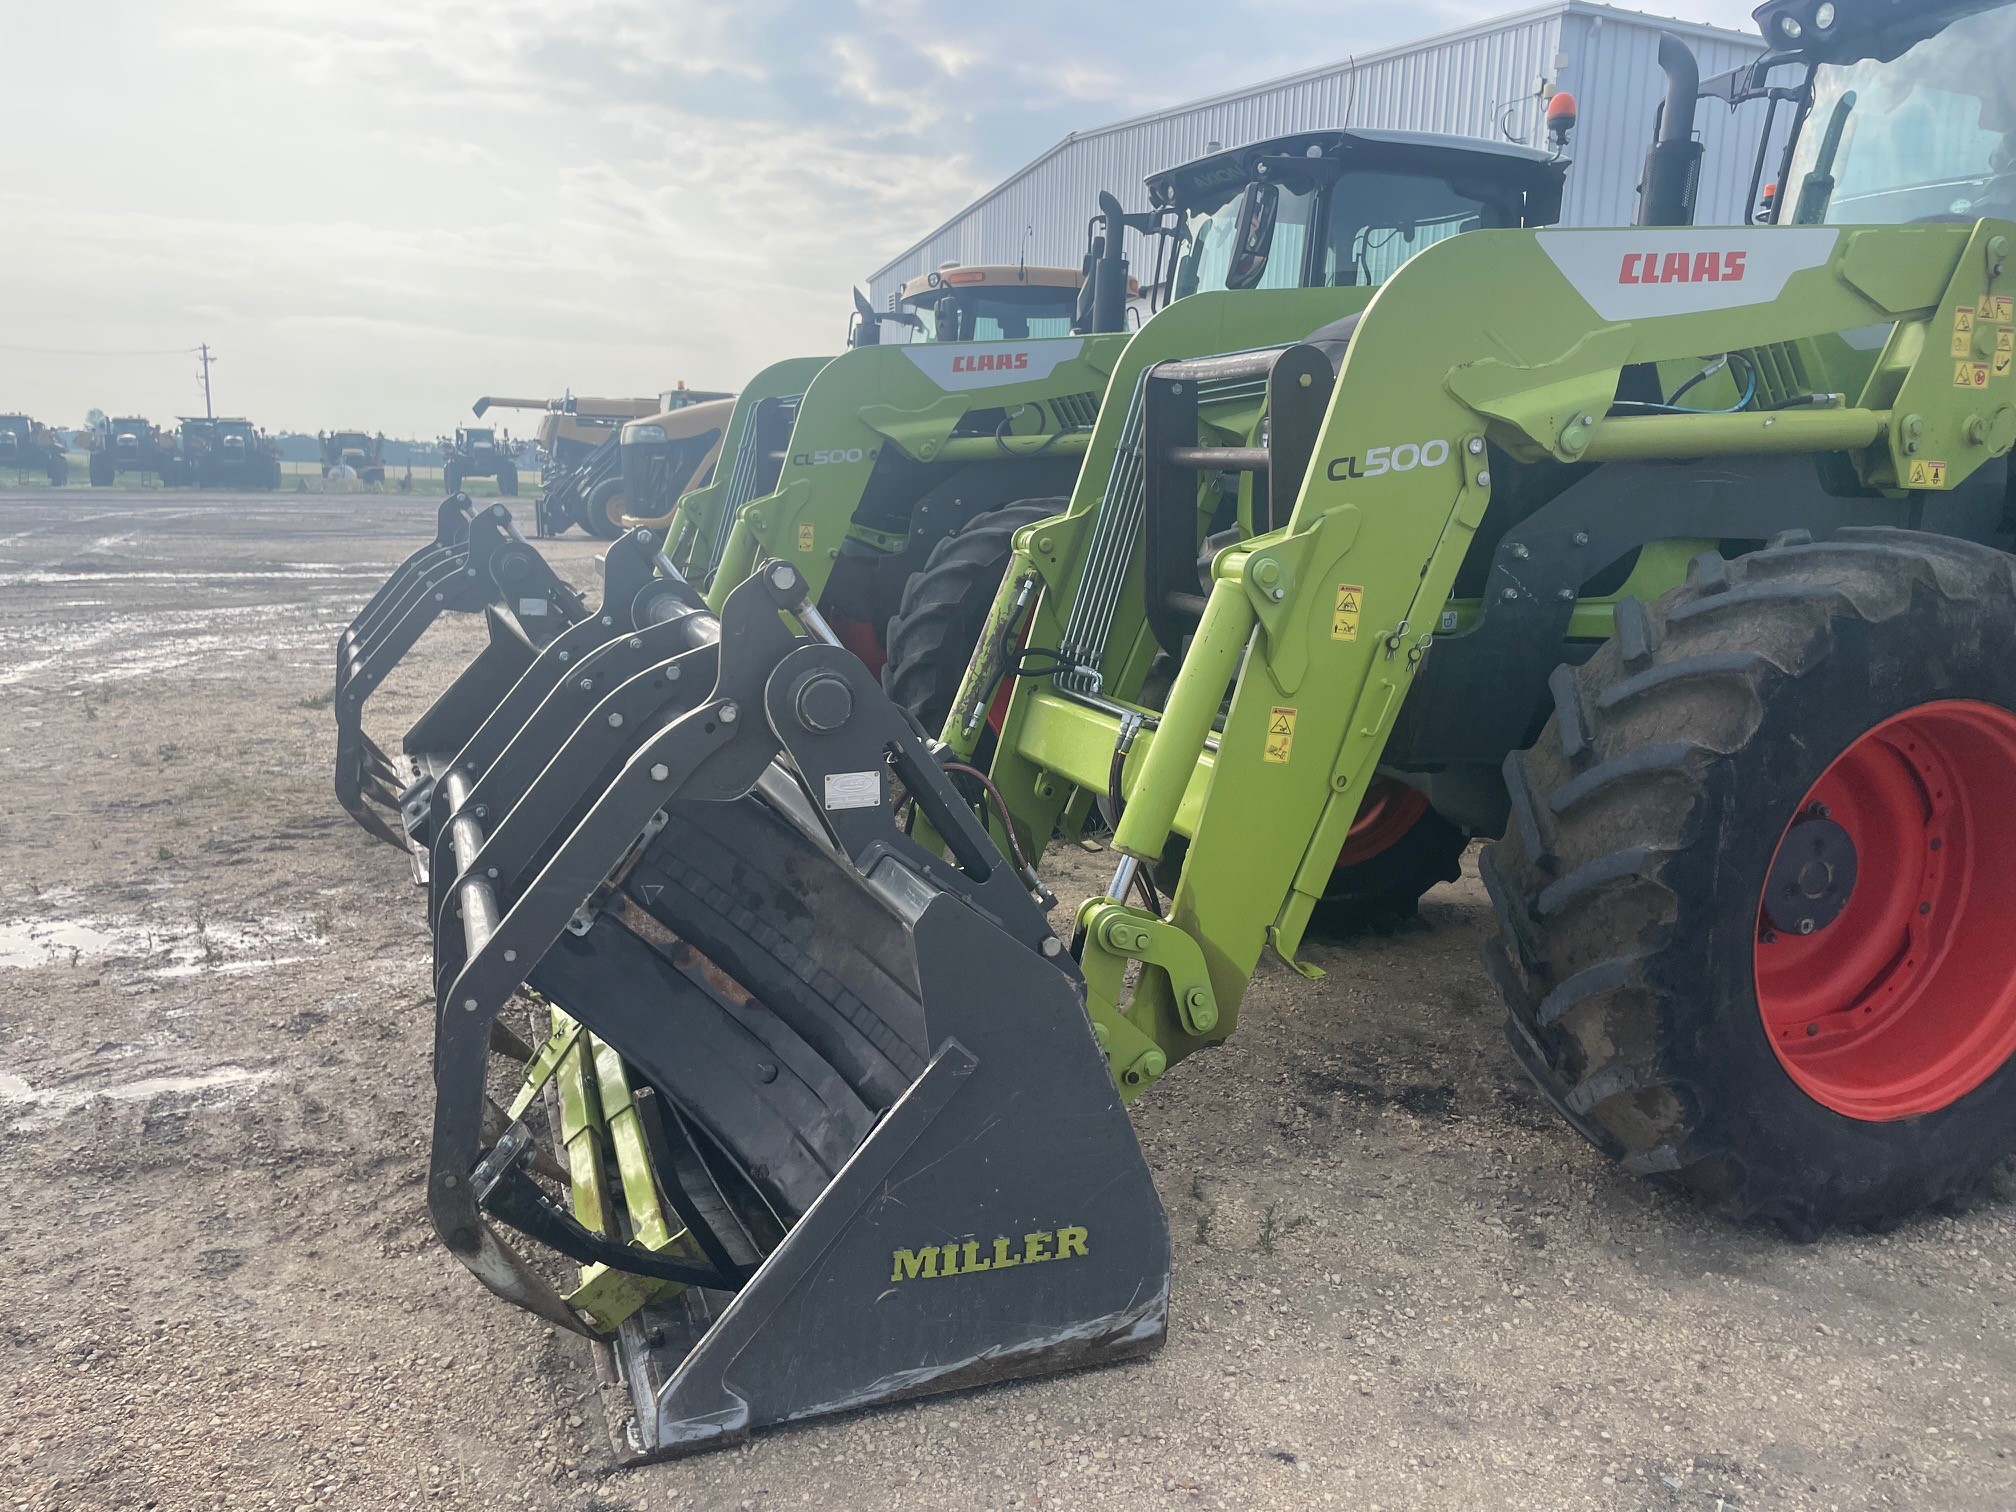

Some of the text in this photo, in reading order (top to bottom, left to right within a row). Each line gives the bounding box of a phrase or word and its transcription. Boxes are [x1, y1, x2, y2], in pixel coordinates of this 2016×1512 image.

[1619, 251, 1747, 284] CLAAS
[952, 353, 1028, 372] CLAAS
[793, 448, 863, 466] CL500
[1327, 439, 1449, 481] CL500
[891, 1226, 1089, 1282] MILLER
